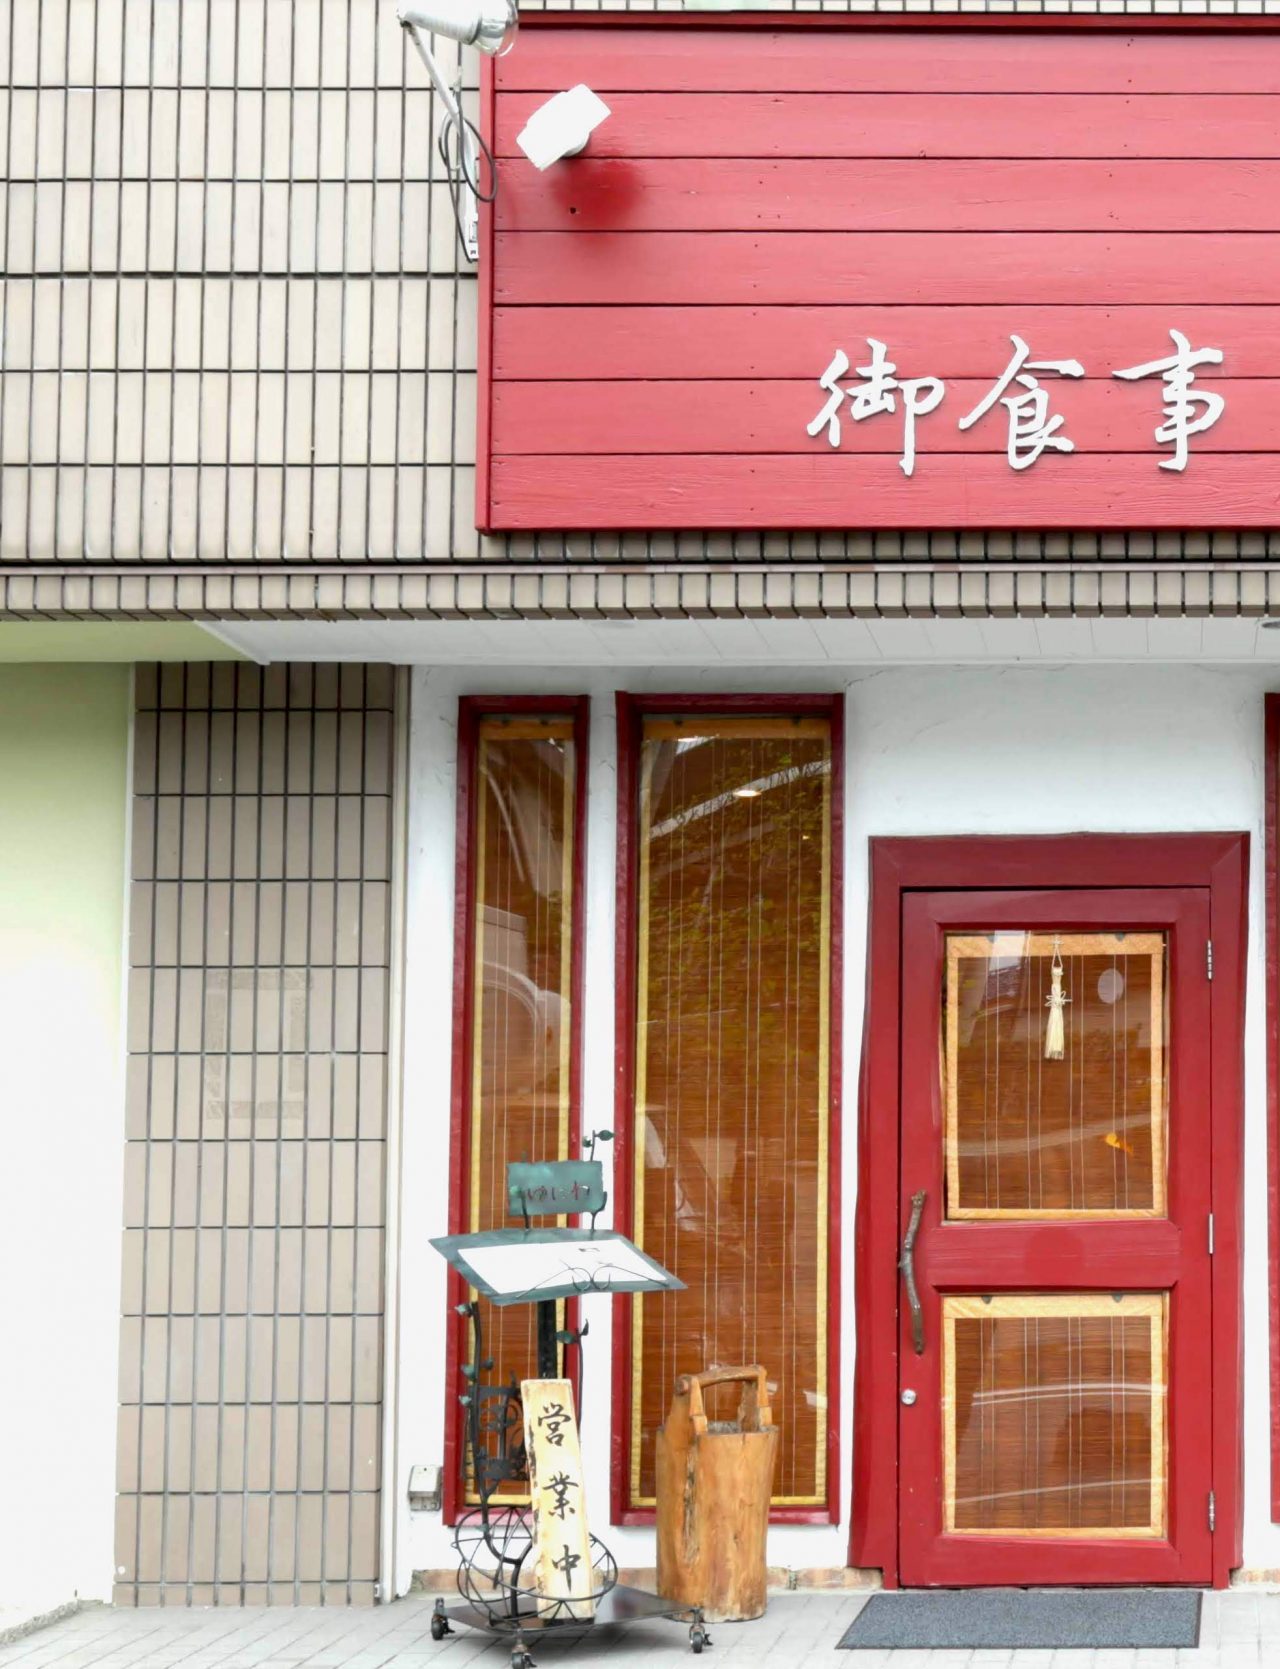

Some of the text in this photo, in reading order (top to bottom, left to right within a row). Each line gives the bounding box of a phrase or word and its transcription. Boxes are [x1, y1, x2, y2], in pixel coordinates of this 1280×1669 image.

[806, 328, 1225, 476] 御食事
[537, 1401, 582, 1594] 営業中
